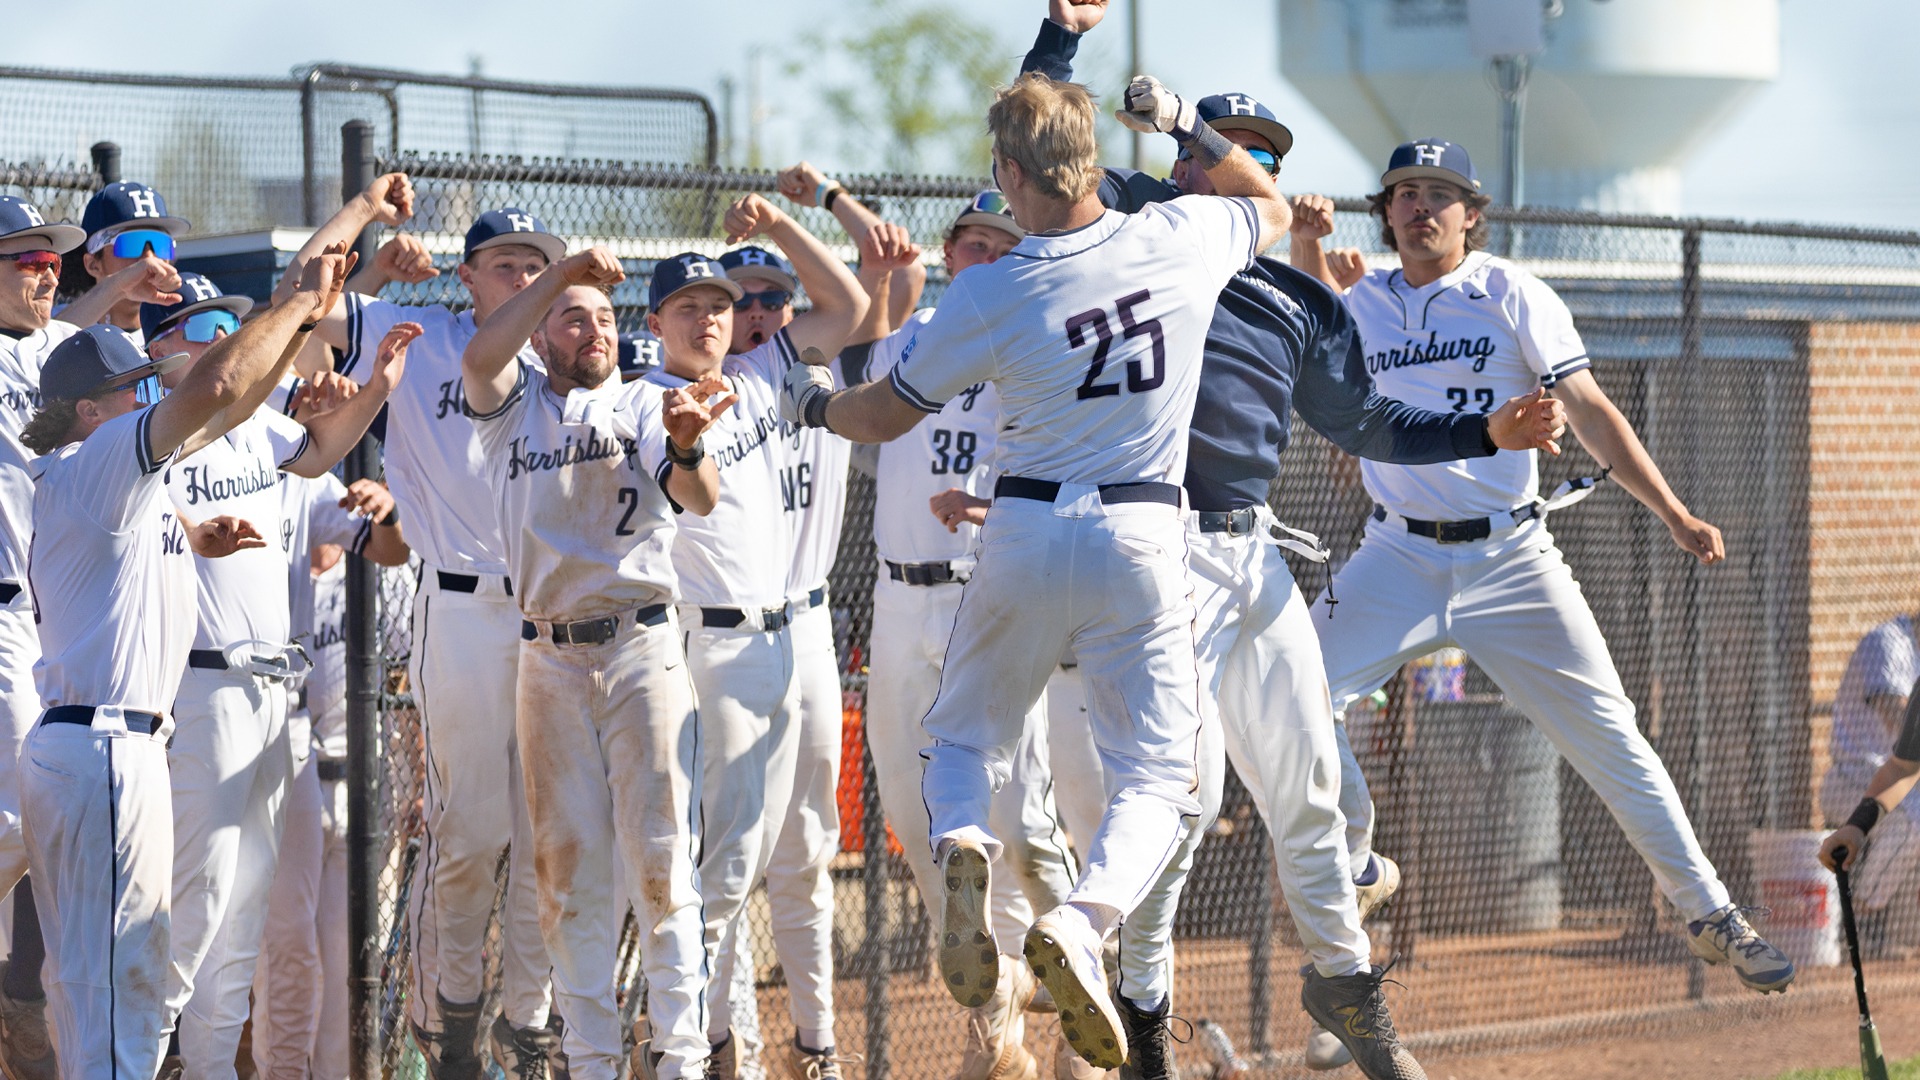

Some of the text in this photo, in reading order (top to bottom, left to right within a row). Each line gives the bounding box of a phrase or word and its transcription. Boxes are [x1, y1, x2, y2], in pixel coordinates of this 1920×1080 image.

[1226, 96, 1258, 116] H
[1415, 144, 1446, 167] H
[18, 204, 46, 228] H
[128, 190, 160, 218] H
[507, 213, 535, 233] H
[679, 254, 714, 279] H
[738, 250, 768, 267] H
[186, 275, 219, 302] H
[632, 339, 661, 366] H
[1065, 288, 1165, 401] 25
[931, 428, 977, 475] 38
[615, 487, 638, 537] 2
